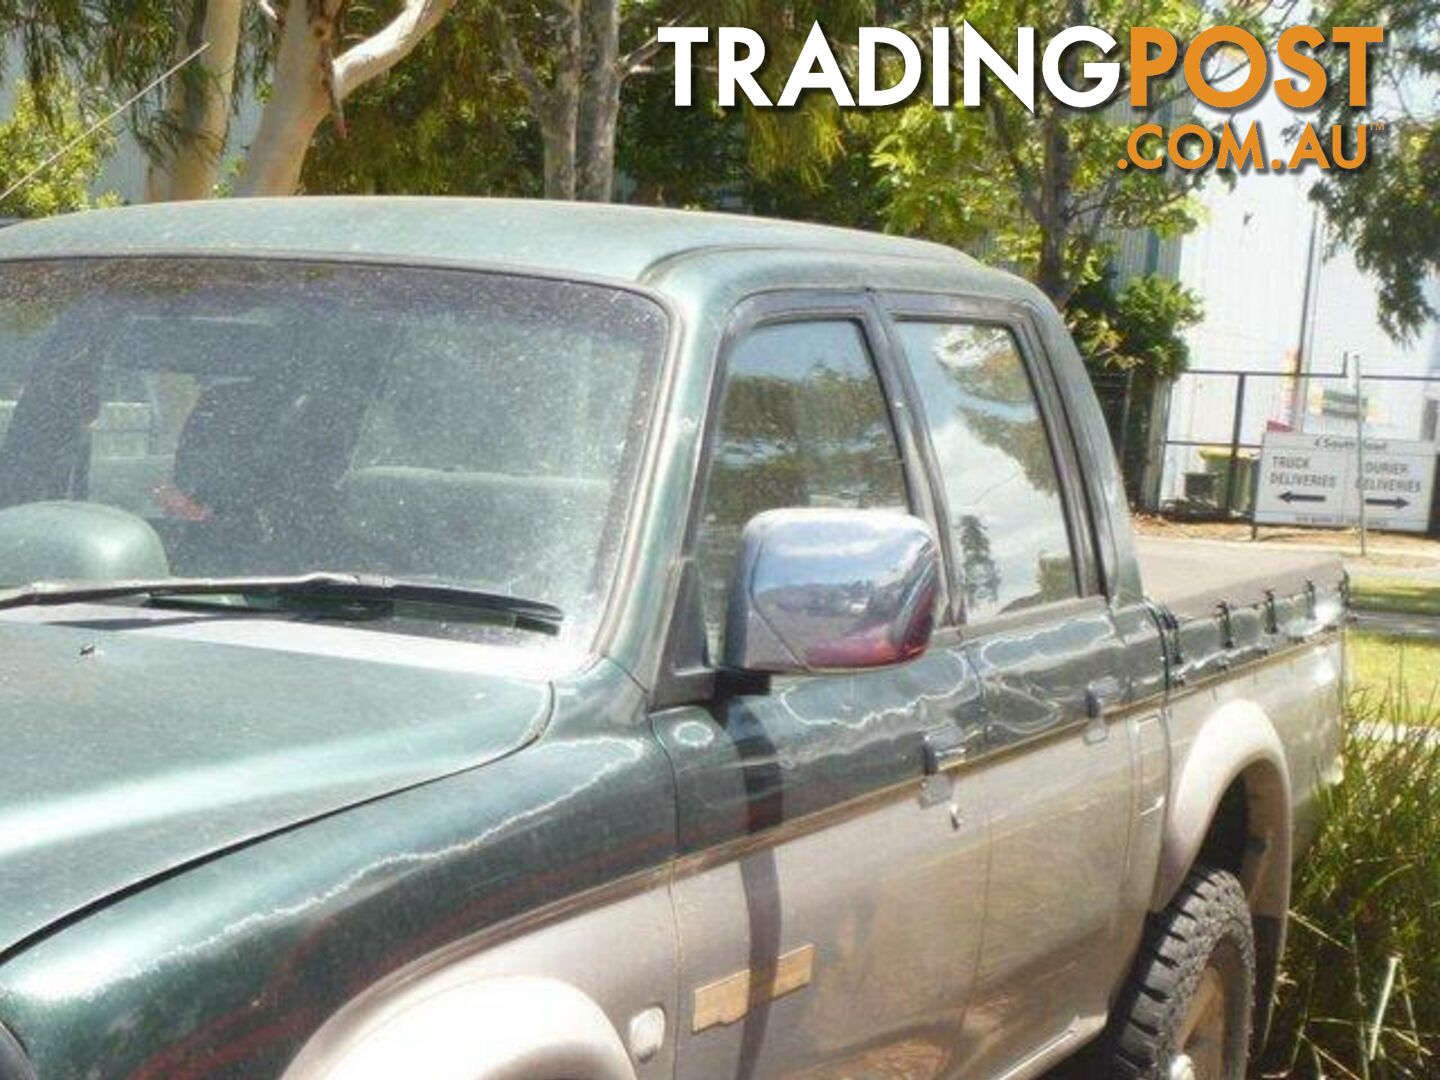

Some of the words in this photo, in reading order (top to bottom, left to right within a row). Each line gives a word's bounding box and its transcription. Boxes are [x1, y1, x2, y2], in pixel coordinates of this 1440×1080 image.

[1271, 455, 1310, 470] TRUCK
[1364, 460, 1409, 477] OURIER
[1269, 472, 1337, 488] DELIVERIES
